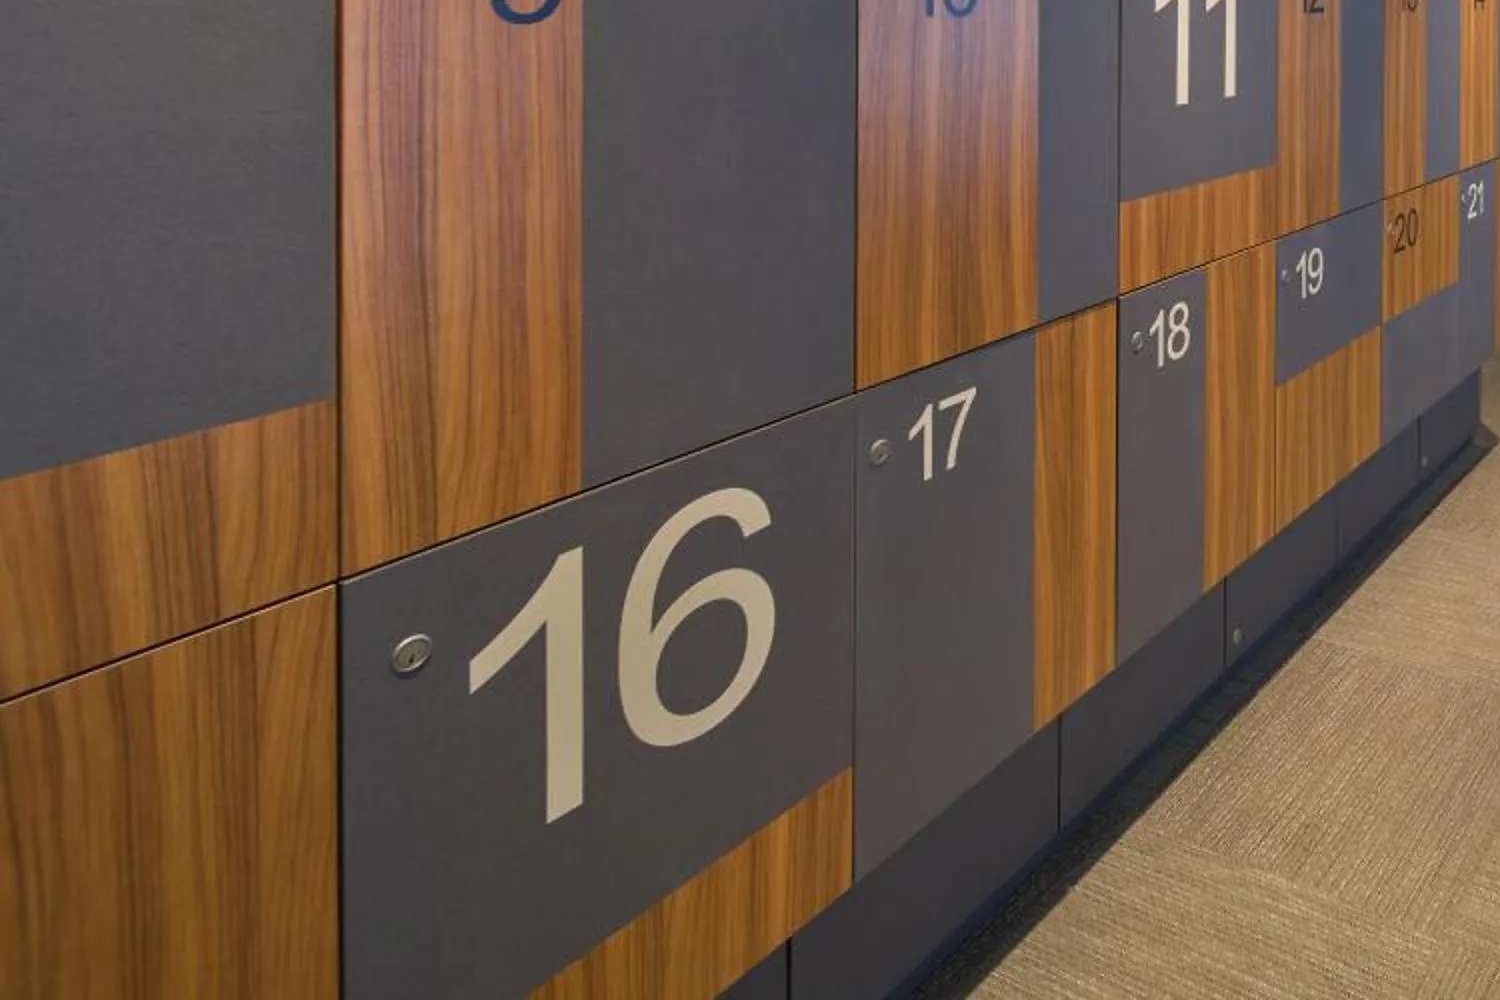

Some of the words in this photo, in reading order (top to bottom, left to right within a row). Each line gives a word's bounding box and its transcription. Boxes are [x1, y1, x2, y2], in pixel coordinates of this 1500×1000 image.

[1467, 180, 1484, 220] 21
[1394, 209, 1418, 252] 20
[1296, 248, 1324, 298] 19
[1149, 302, 1190, 367] 18
[908, 387, 977, 482] 17
[469, 487, 776, 824] 16
